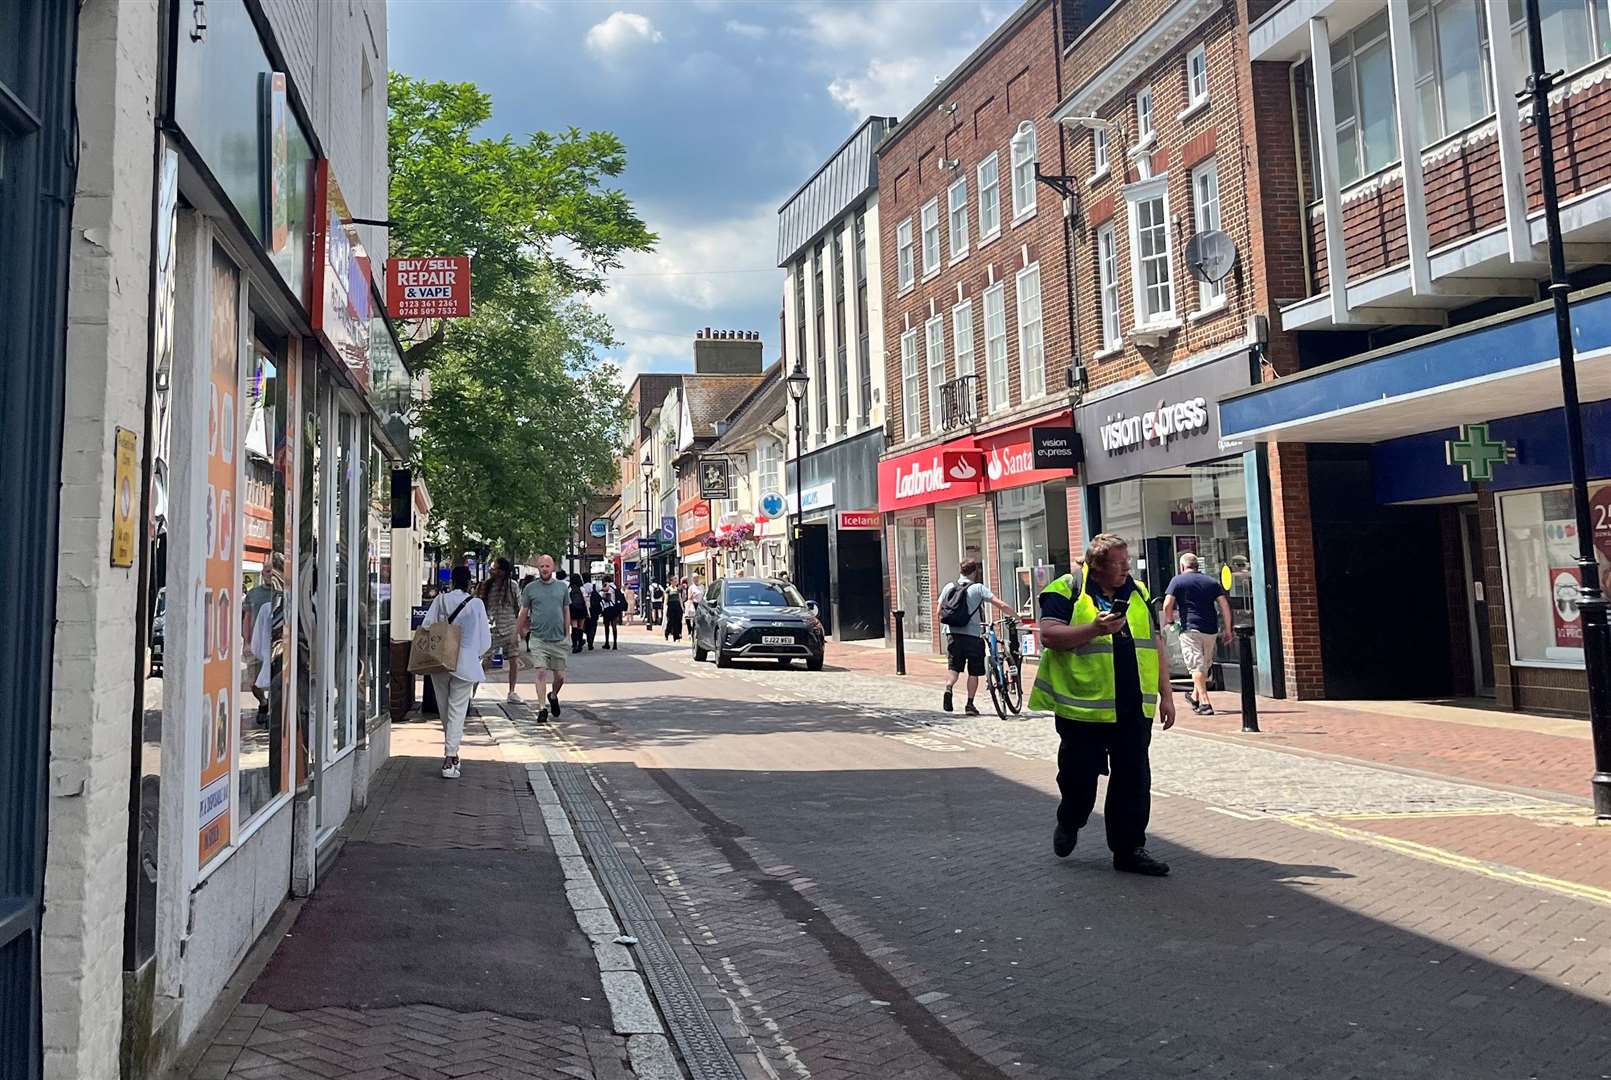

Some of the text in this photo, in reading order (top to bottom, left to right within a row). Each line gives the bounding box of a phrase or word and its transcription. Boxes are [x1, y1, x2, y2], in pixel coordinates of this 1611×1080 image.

[398, 260, 458, 271] BUY/SELL
[397, 272, 456, 286] REPAIR
[407, 288, 449, 297] & VAPE
[421, 300, 436, 308] 361
[438, 300, 458, 308] 2361
[399, 308, 418, 316] 0748
[438, 307, 457, 315] 7532
[1100, 399, 1206, 451] vision express
[1042, 439, 1067, 447] vision
[1037, 448, 1072, 457] express
[896, 457, 951, 499] Ladbroke
[844, 515, 880, 526] Iceland
